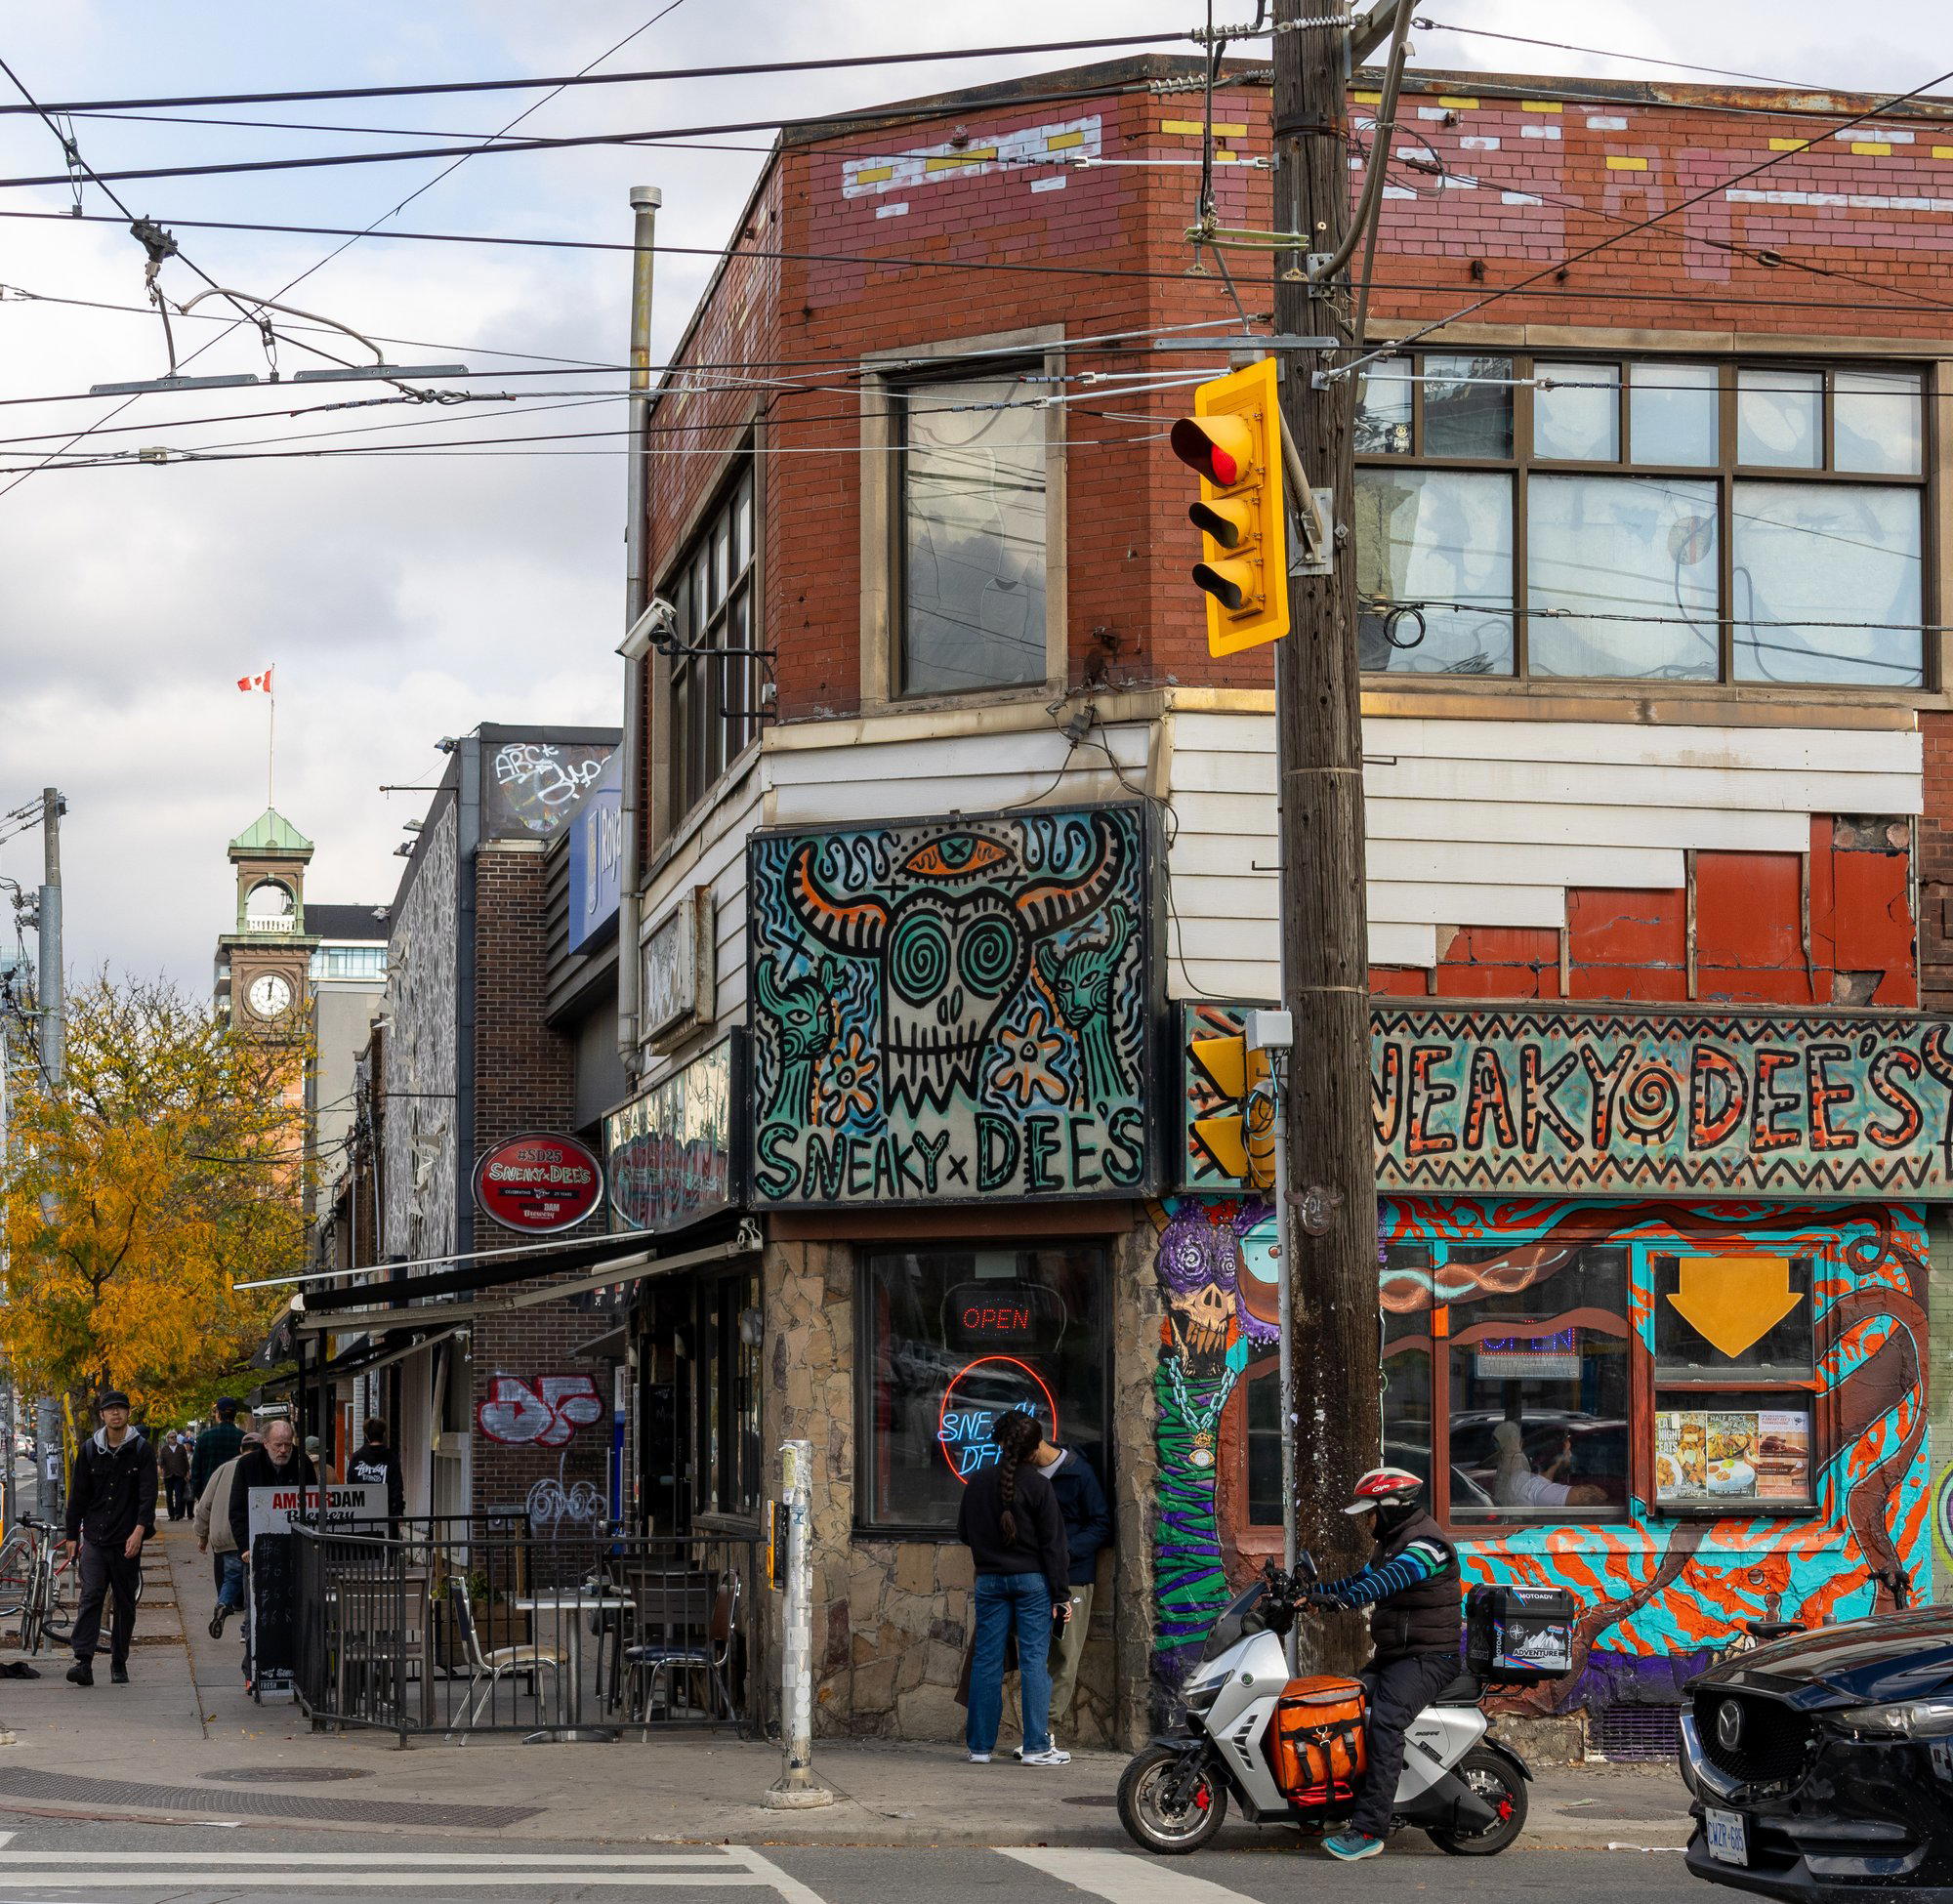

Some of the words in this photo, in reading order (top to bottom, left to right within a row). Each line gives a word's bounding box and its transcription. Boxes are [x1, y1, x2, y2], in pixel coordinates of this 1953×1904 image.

[1371, 1042, 1633, 1157] NEAKY
[1688, 1034, 1924, 1153] DEE'S
[517, 1149, 562, 1163] #SD25
[755, 1121, 949, 1201] SNEAKY
[975, 1101, 1144, 1194] DEE'S
[488, 1162, 545, 1182] SNEAKY
[550, 1165, 591, 1184] DEE'S
[963, 1307, 1029, 1329] OPEN
[1658, 1429, 1680, 1440] NIGHT
[1658, 1441, 1678, 1453] EATS
[1513, 1648, 1558, 1657] ADVENTURE
